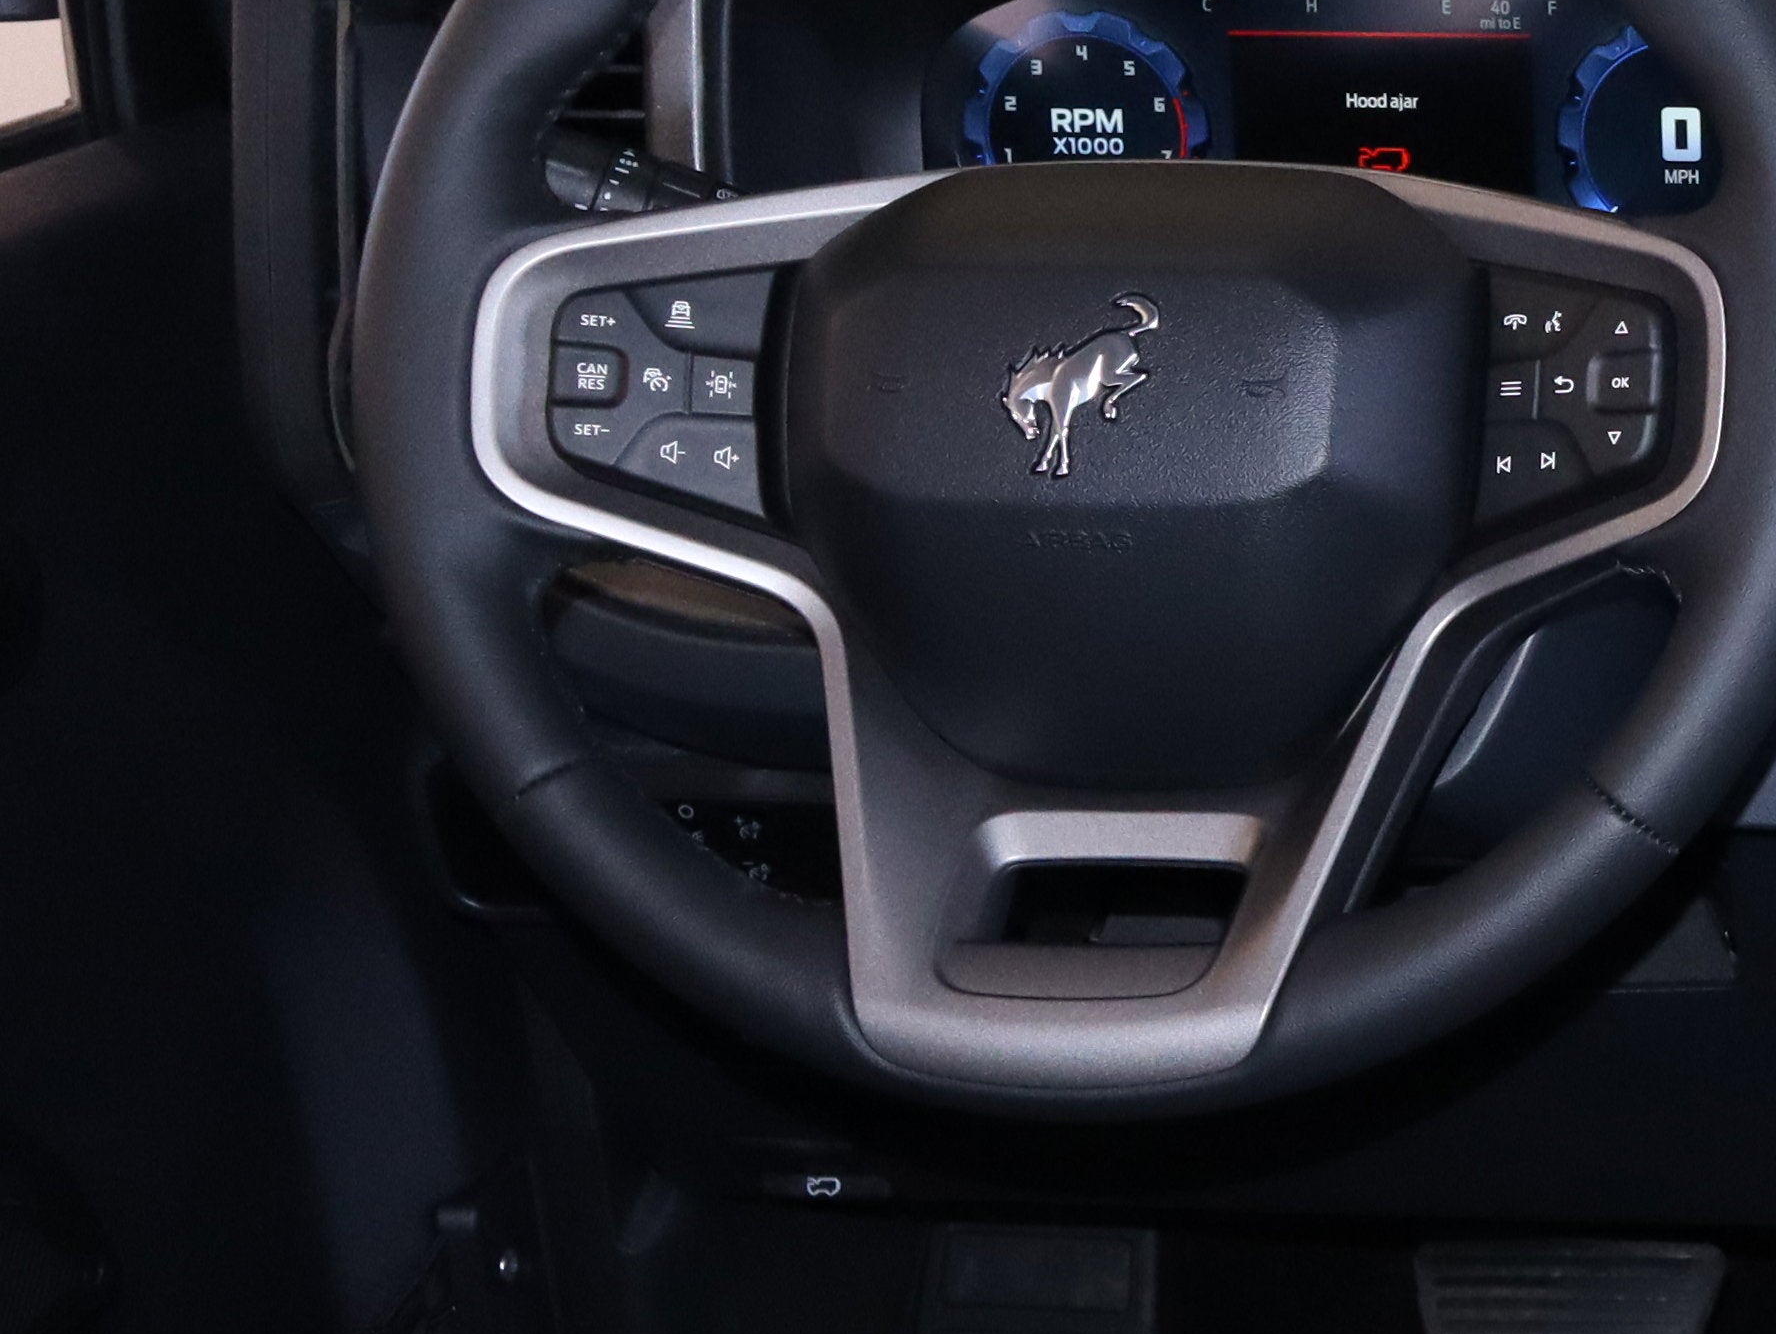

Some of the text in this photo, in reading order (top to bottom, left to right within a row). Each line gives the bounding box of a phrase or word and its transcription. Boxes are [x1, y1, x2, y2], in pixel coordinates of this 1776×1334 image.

[1441, 0, 1451, 15] E
[1490, 0, 1511, 15] 40
[1547, 0, 1557, 15] F
[1480, 17, 1521, 30] mi to E
[1075, 45, 1089, 61] 4
[1030, 59, 1043, 76] 3
[1123, 60, 1136, 77] 5
[1004, 95, 1017, 112] 2
[1153, 97, 1165, 113] 6
[1345, 92, 1419, 112] Hood ajar
[1050, 107, 1125, 134] RPM
[1661, 106, 1702, 163] 0
[1053, 136, 1124, 156] X1000
[1004, 147, 1013, 164] 1
[1664, 169, 1700, 185] MPH
[580, 314, 616, 328] SET+
[576, 362, 608, 376] CAN
[577, 378, 605, 391] RES
[1611, 376, 1630, 389] OK
